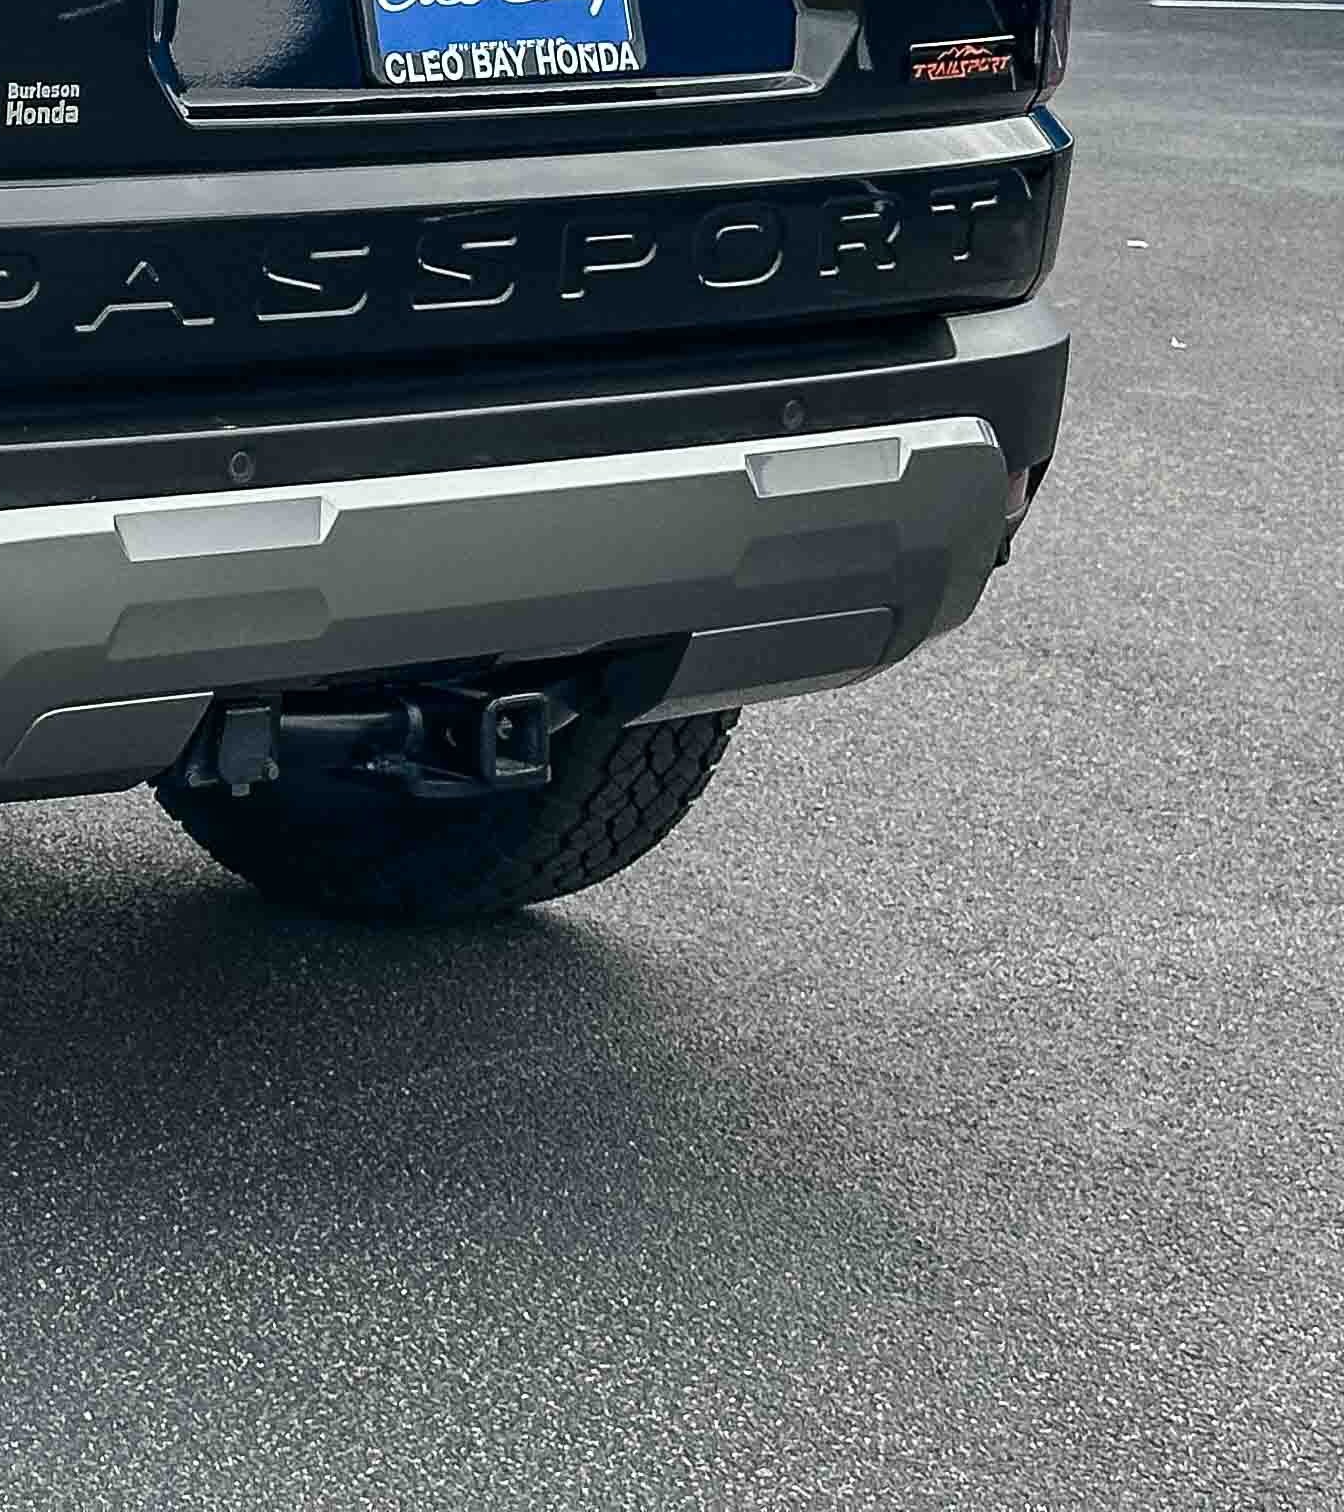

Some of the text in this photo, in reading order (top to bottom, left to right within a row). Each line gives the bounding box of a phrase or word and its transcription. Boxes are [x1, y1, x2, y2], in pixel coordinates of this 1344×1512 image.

[384, 49, 463, 85] CLEO
[471, 44, 527, 79] BAY
[534, 40, 640, 76] HONDA
[912, 55, 1011, 80] TRAILSPORT
[7, 81, 80, 99] Burleson
[6, 99, 79, 126] Honda
